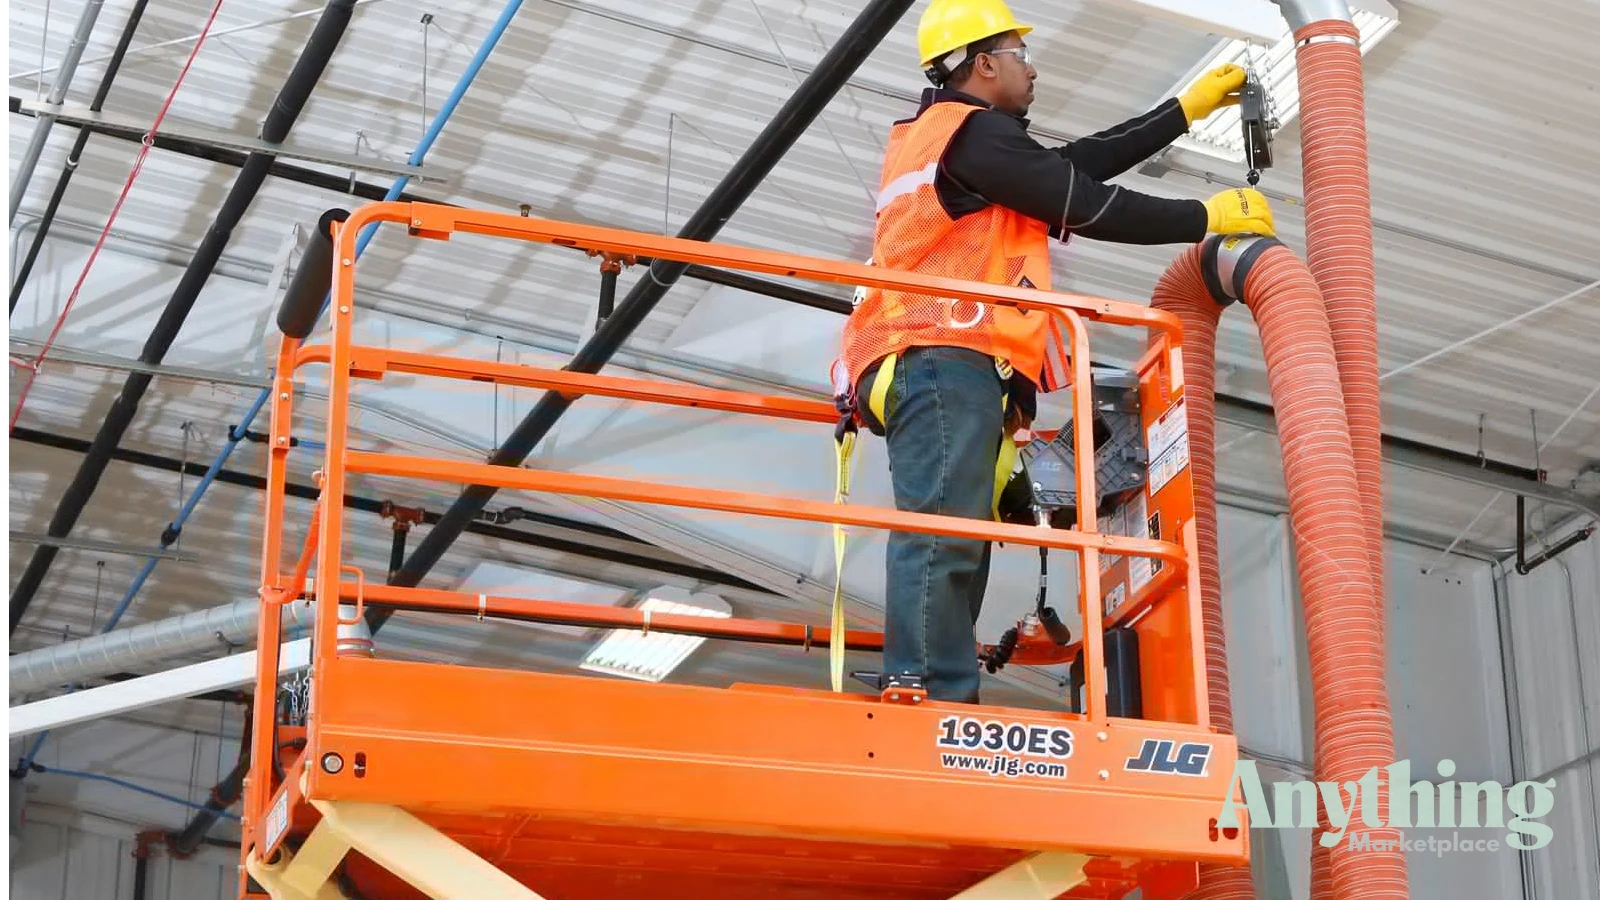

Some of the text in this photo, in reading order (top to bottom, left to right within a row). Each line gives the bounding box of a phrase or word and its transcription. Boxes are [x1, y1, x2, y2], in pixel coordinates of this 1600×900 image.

[939, 718, 1071, 756] 1930ES
[942, 755, 1065, 776] www.jlg.com
[1126, 740, 1210, 774] JLG
